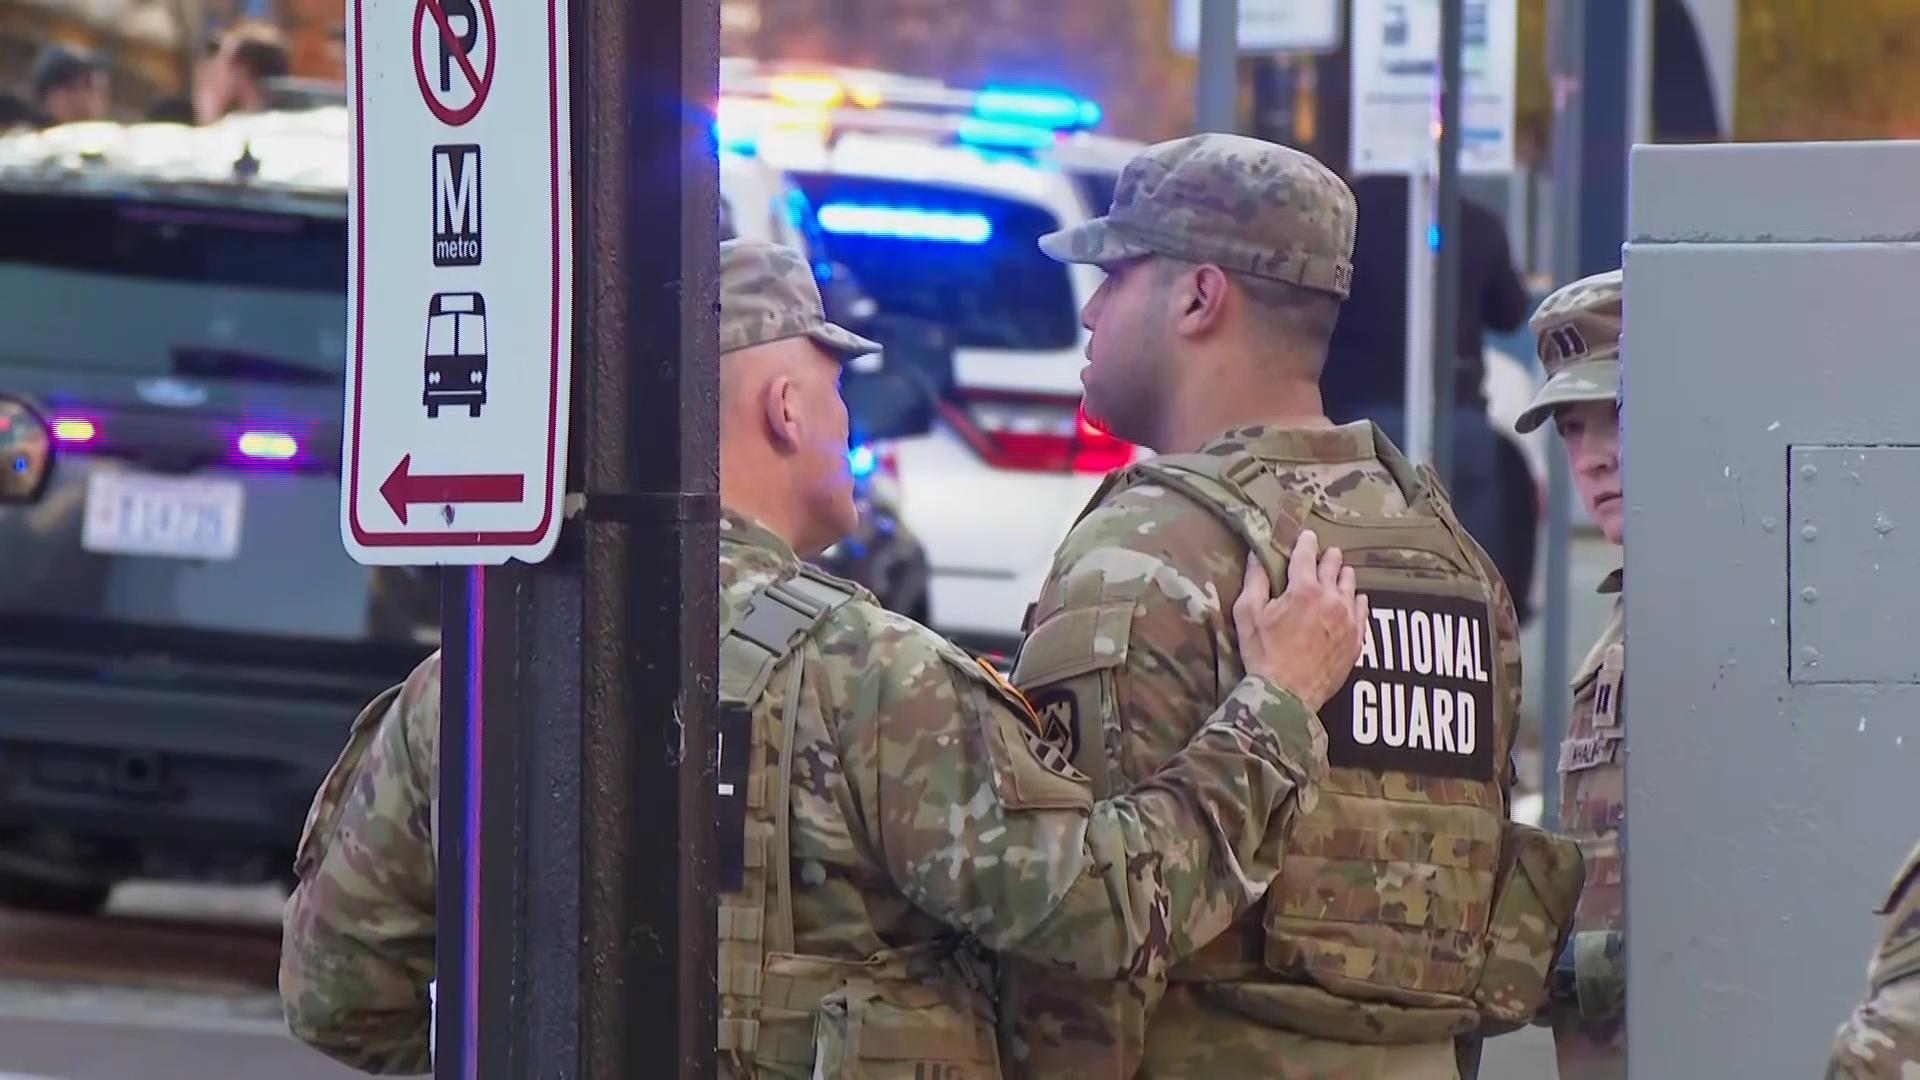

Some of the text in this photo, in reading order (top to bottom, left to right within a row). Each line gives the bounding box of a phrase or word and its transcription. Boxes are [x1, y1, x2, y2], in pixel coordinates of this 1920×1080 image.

[435, 152, 479, 234] M
[436, 237, 478, 259] metro
[1355, 608, 1488, 683] ATIONAL
[1352, 679, 1476, 755] GUARD
